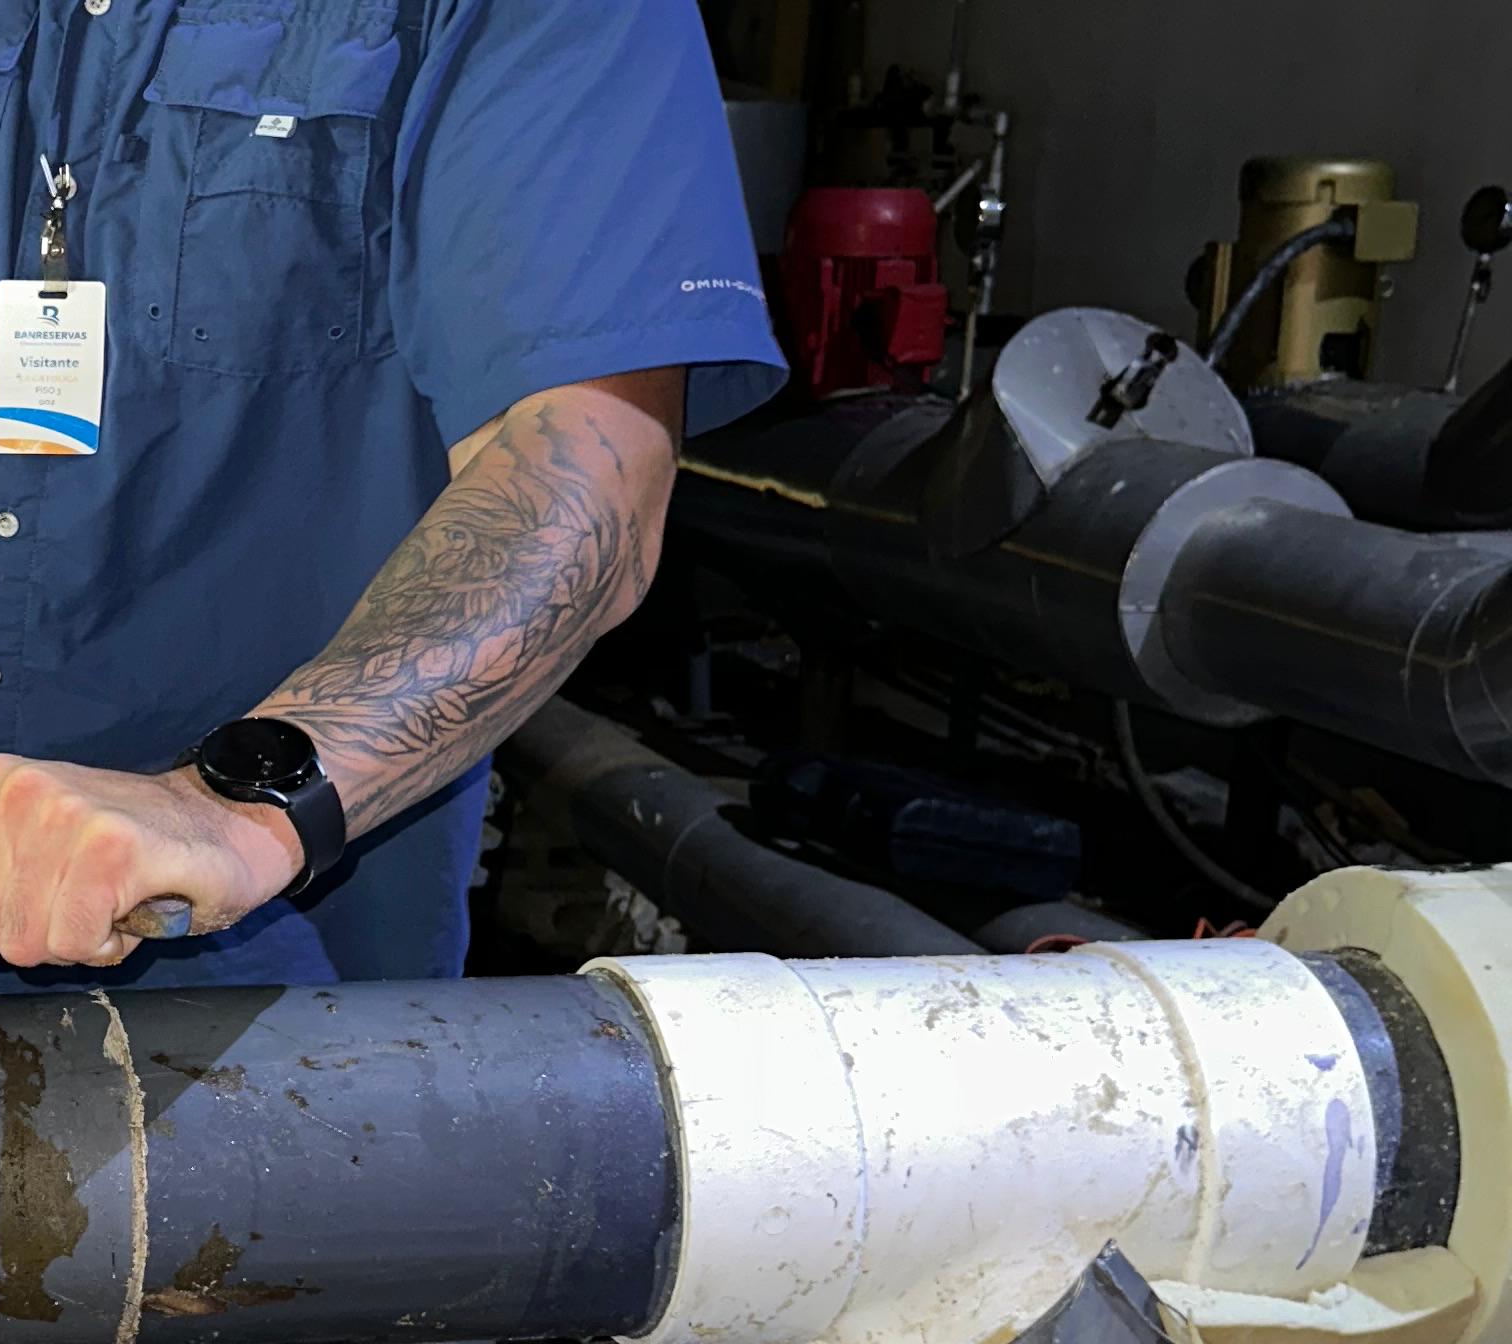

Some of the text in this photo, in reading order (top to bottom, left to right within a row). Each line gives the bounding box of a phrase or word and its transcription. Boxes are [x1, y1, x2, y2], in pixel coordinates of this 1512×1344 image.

[681, 279, 766, 304] OMNI-S
[14, 331, 87, 340] BANRESERVAS
[20, 356, 80, 368] Visitante
